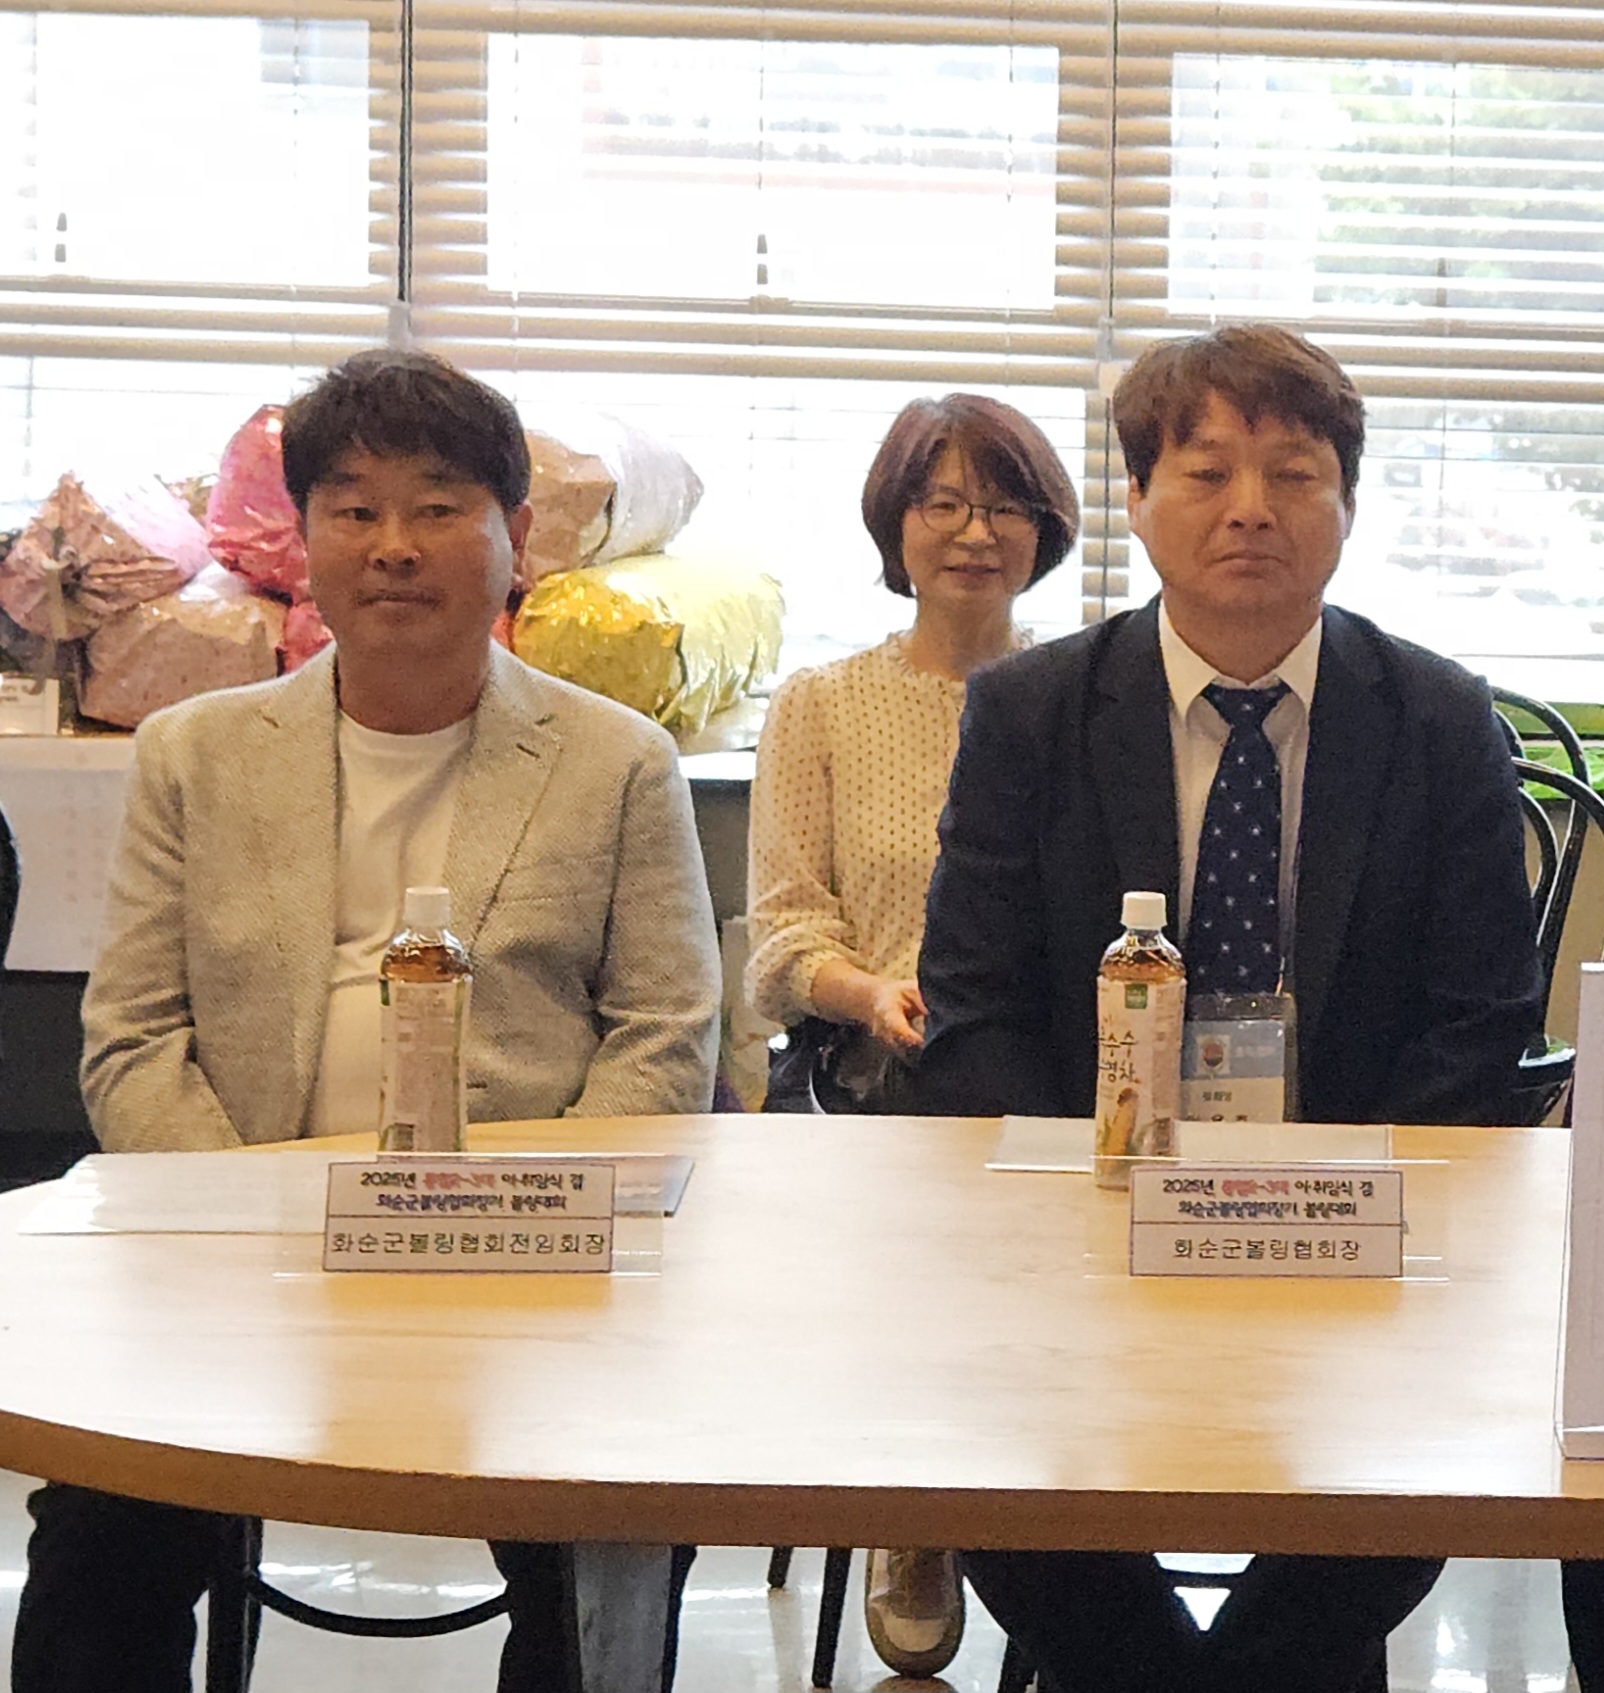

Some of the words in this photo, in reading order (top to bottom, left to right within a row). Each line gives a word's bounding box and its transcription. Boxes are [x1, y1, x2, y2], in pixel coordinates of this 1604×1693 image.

[360, 1172, 417, 1190] 2025년
[1162, 1178, 1215, 1197] 2025년
[331, 1232, 605, 1257] 화순군볼링협회전임회장
[1173, 1237, 1362, 1261] 화순군볼링협회장
